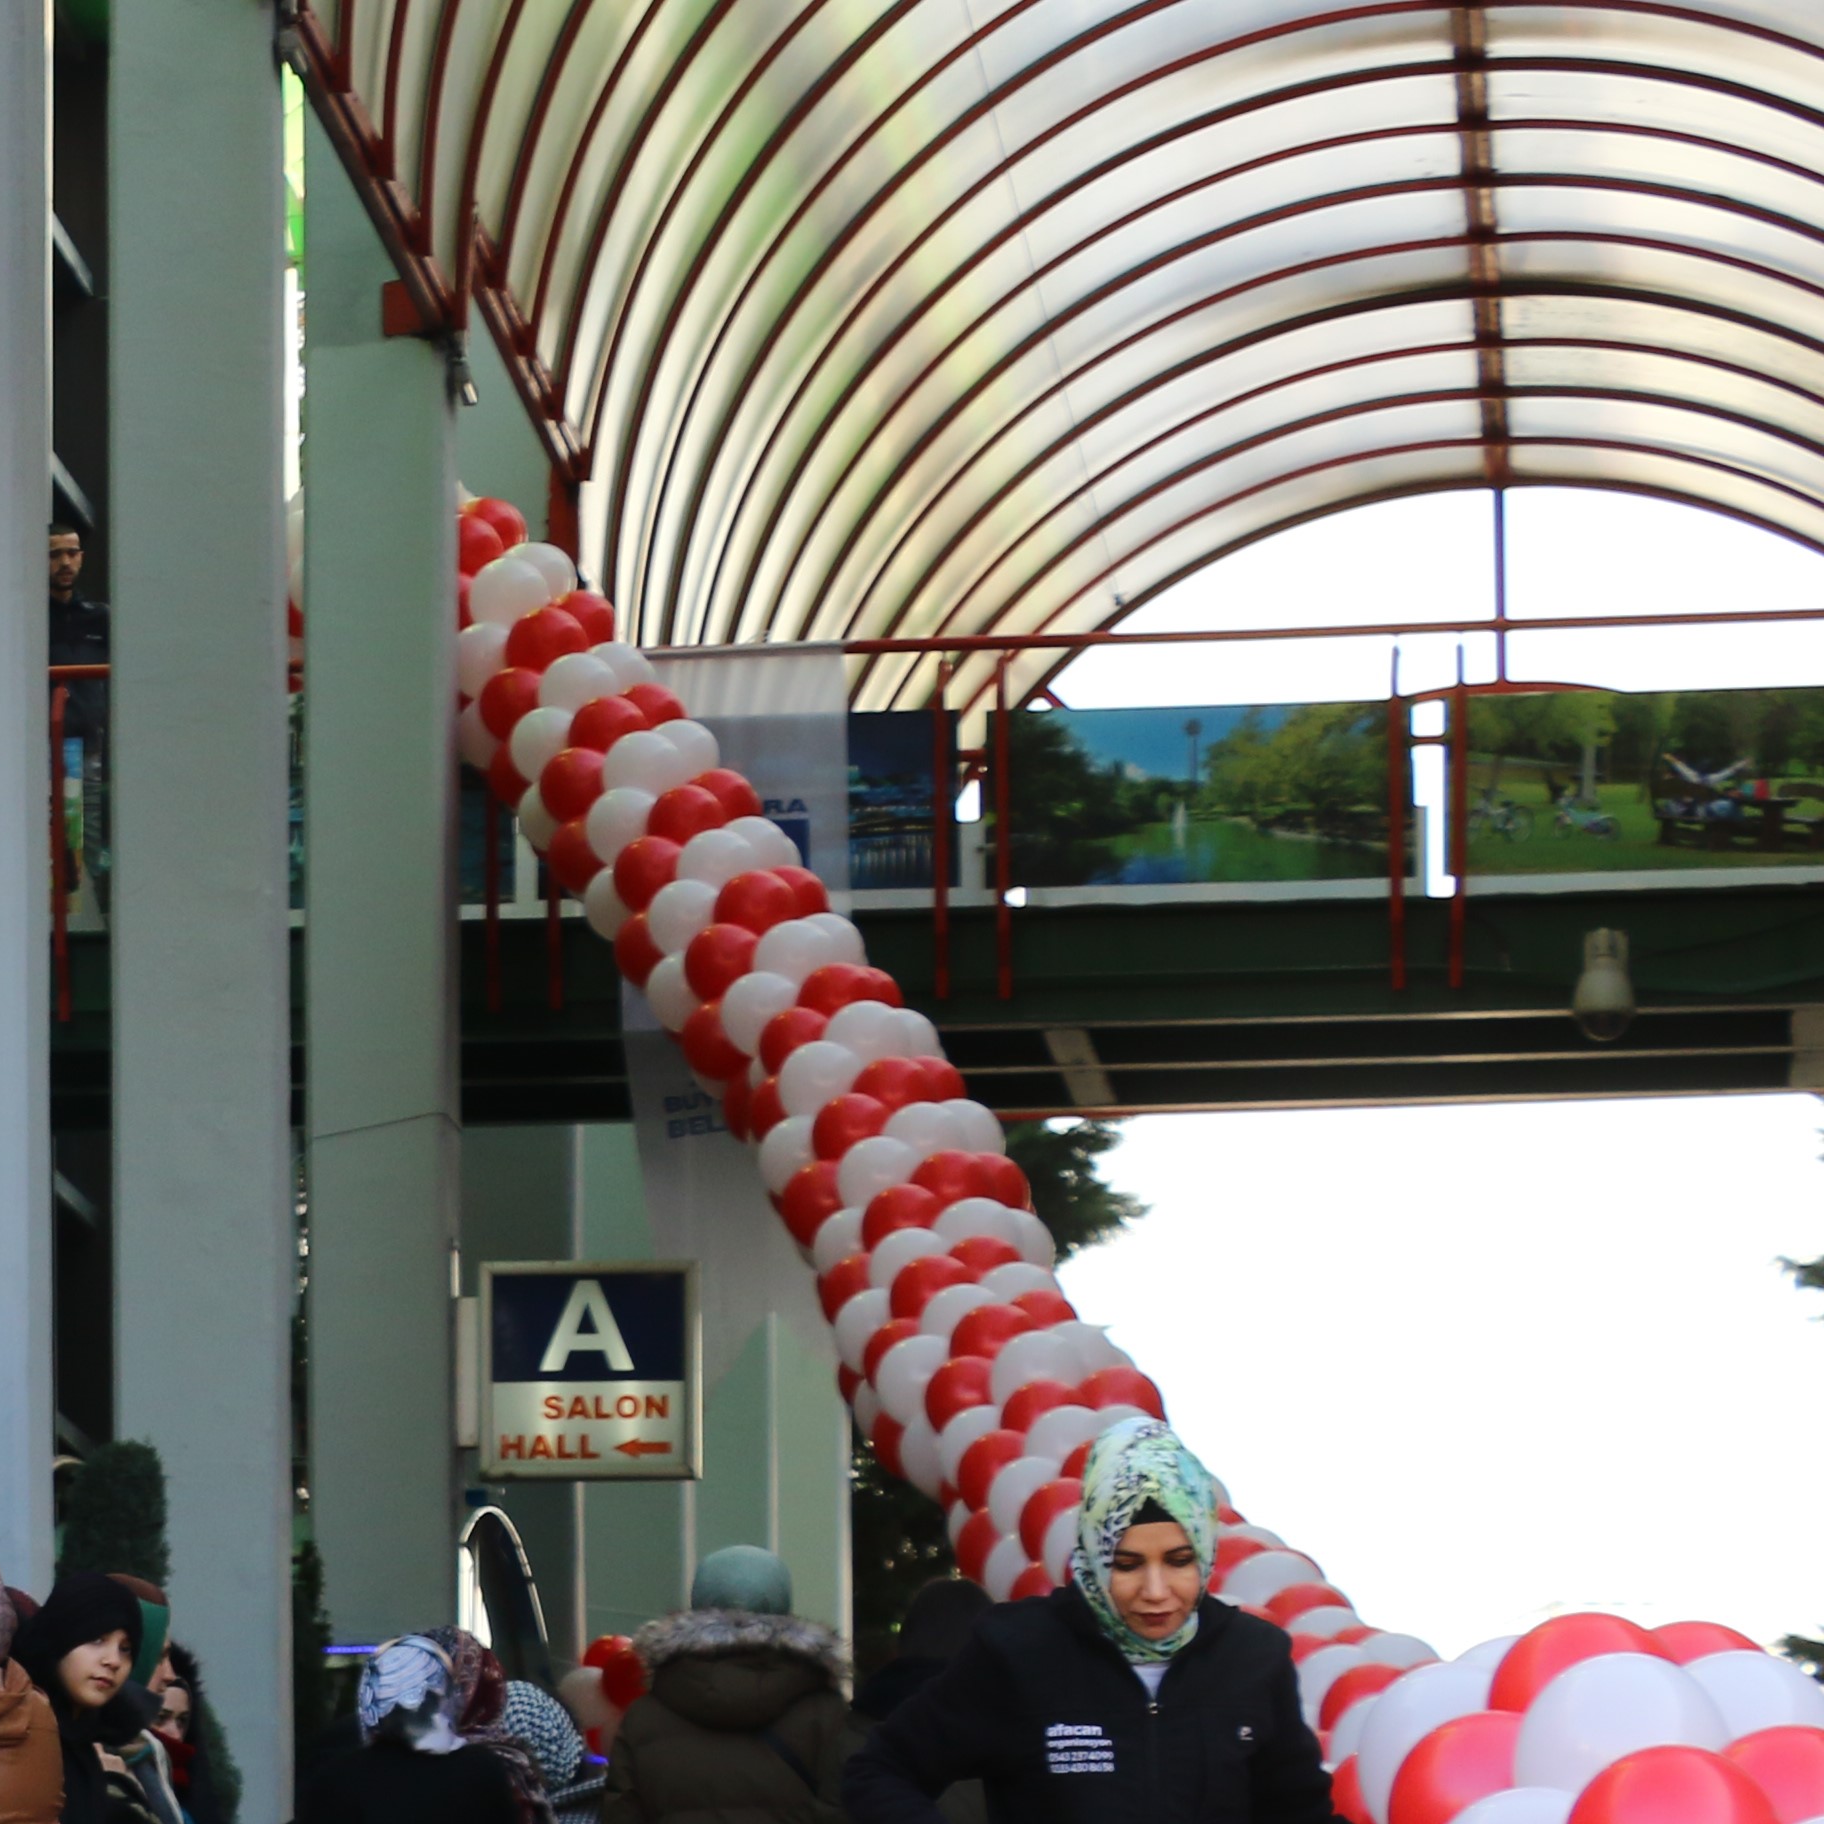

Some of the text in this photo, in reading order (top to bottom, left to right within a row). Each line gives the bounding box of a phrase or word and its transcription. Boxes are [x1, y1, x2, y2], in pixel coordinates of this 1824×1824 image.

[539, 1280, 635, 1372] A
[543, 1395, 669, 1419] SALON
[500, 1433, 601, 1460] HALL
[1046, 1723, 1102, 1737] afacan
